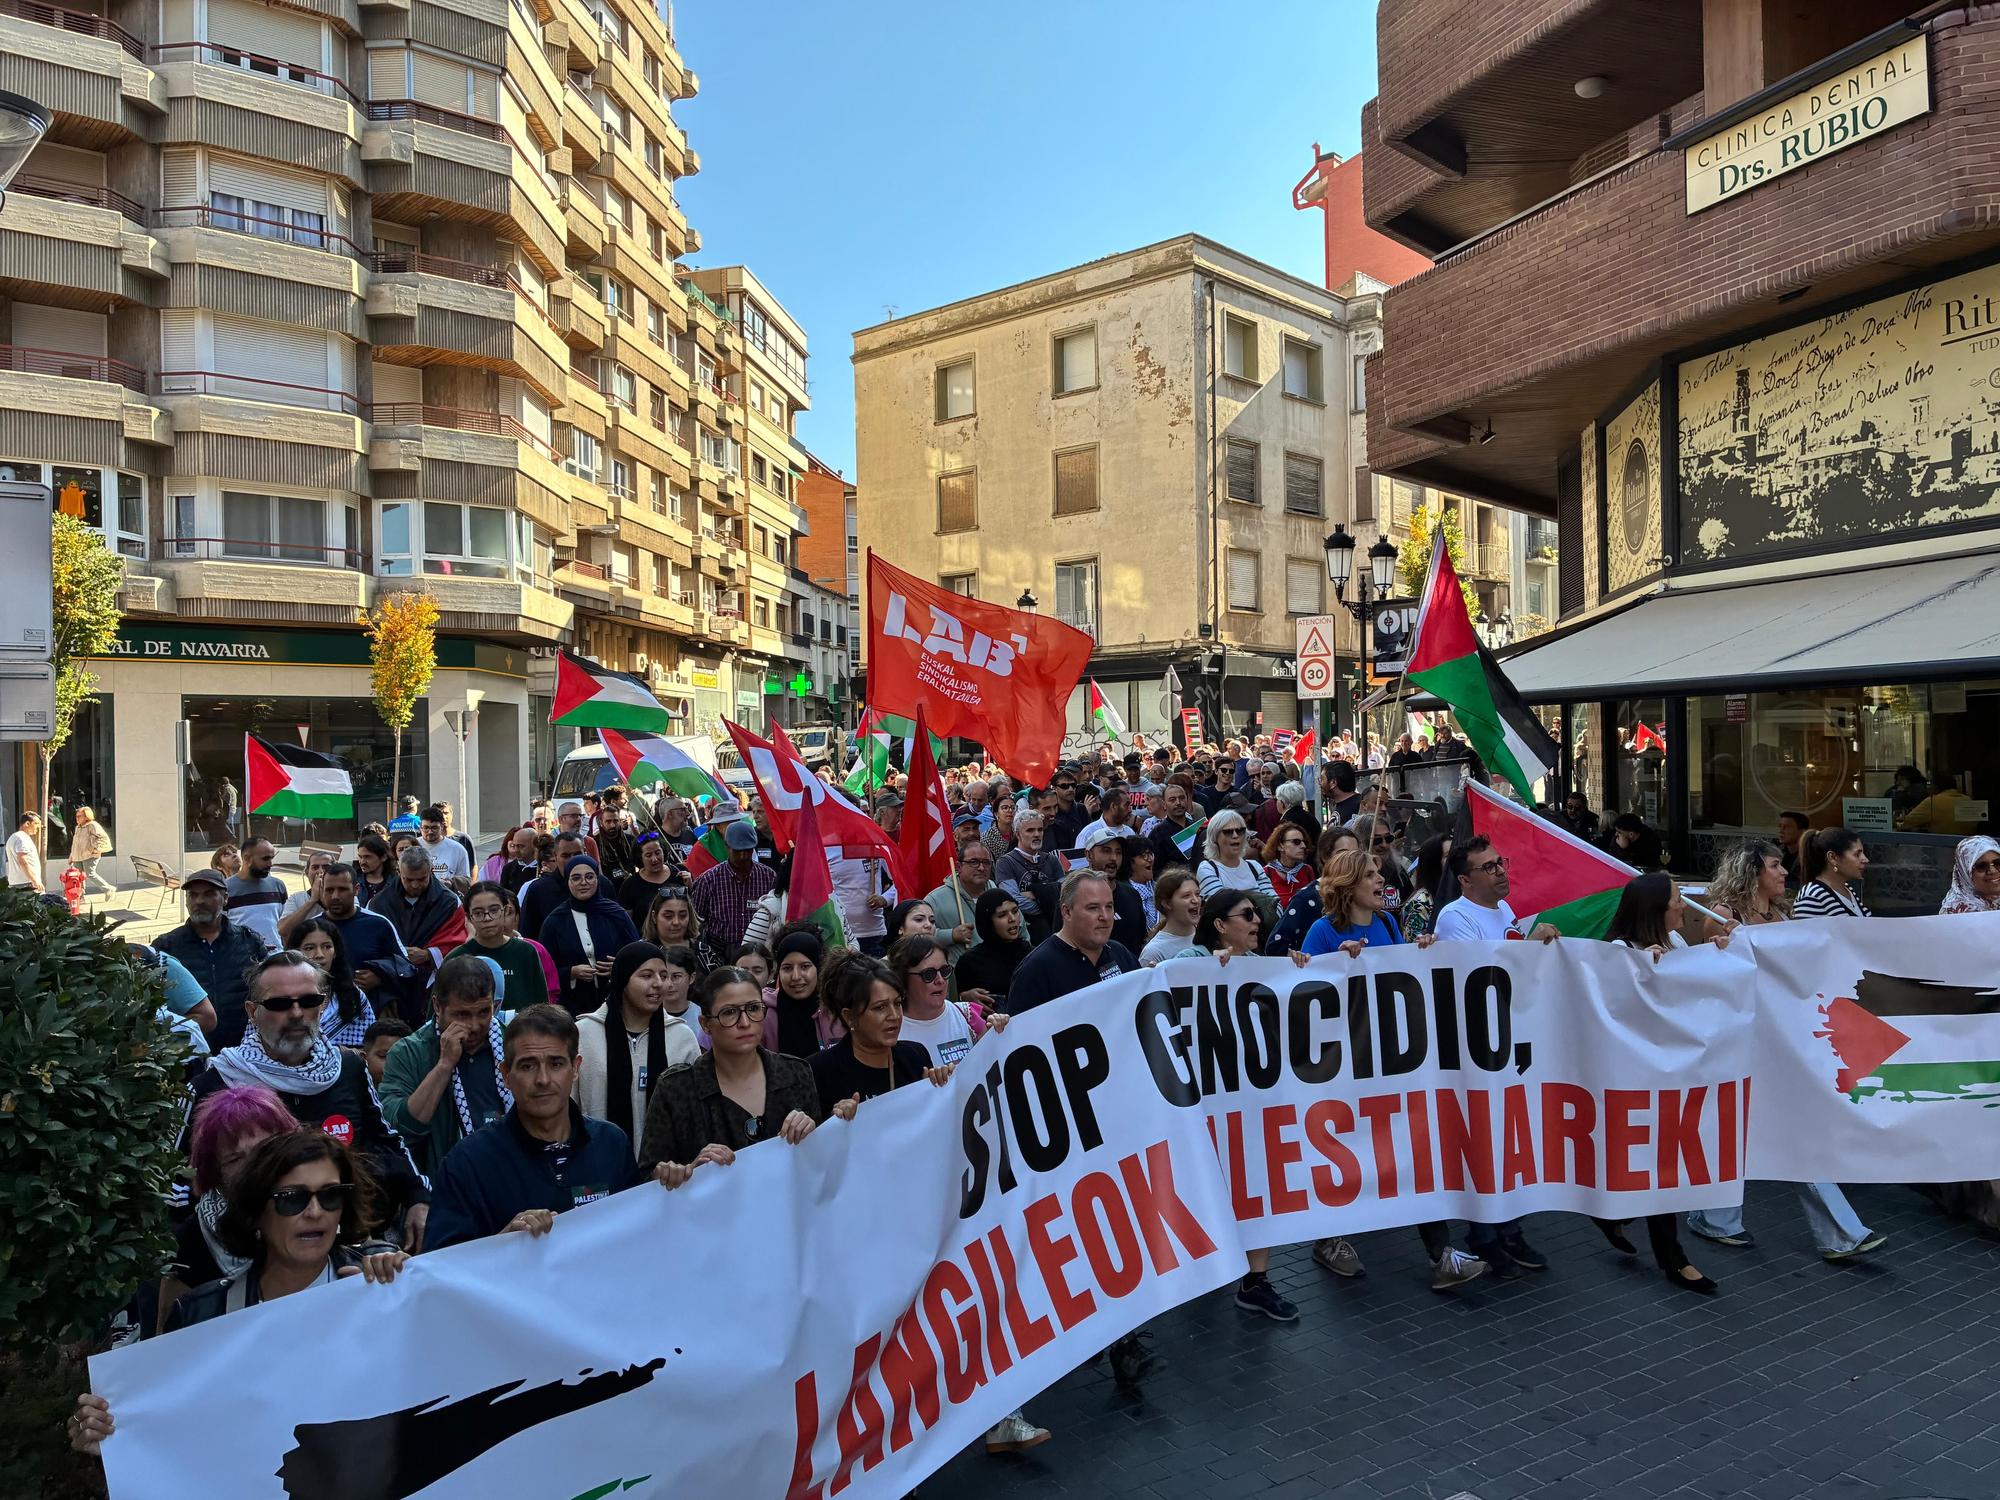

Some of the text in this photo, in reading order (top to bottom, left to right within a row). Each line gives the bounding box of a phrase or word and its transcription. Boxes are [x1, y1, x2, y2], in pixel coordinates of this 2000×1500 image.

[1698, 53, 1912, 168] CLINICA DENTAL
[1719, 96, 1888, 196] Drs. RUBIO
[883, 590, 1016, 677] LAB
[1298, 616, 1332, 627] ATENCIÓN
[144, 640, 172, 655] DE
[180, 641, 270, 658] NAVARRA
[920, 652, 955, 676] EUSKAL
[917, 671, 982, 706] ERALDATZAILEA
[919, 661, 978, 694] SINDIKALISMO
[1307, 669, 1324, 680] 30
[959, 1023, 1110, 1219] STOP
[787, 1076, 1751, 1500] LANGILEOK LESTINAREKI
